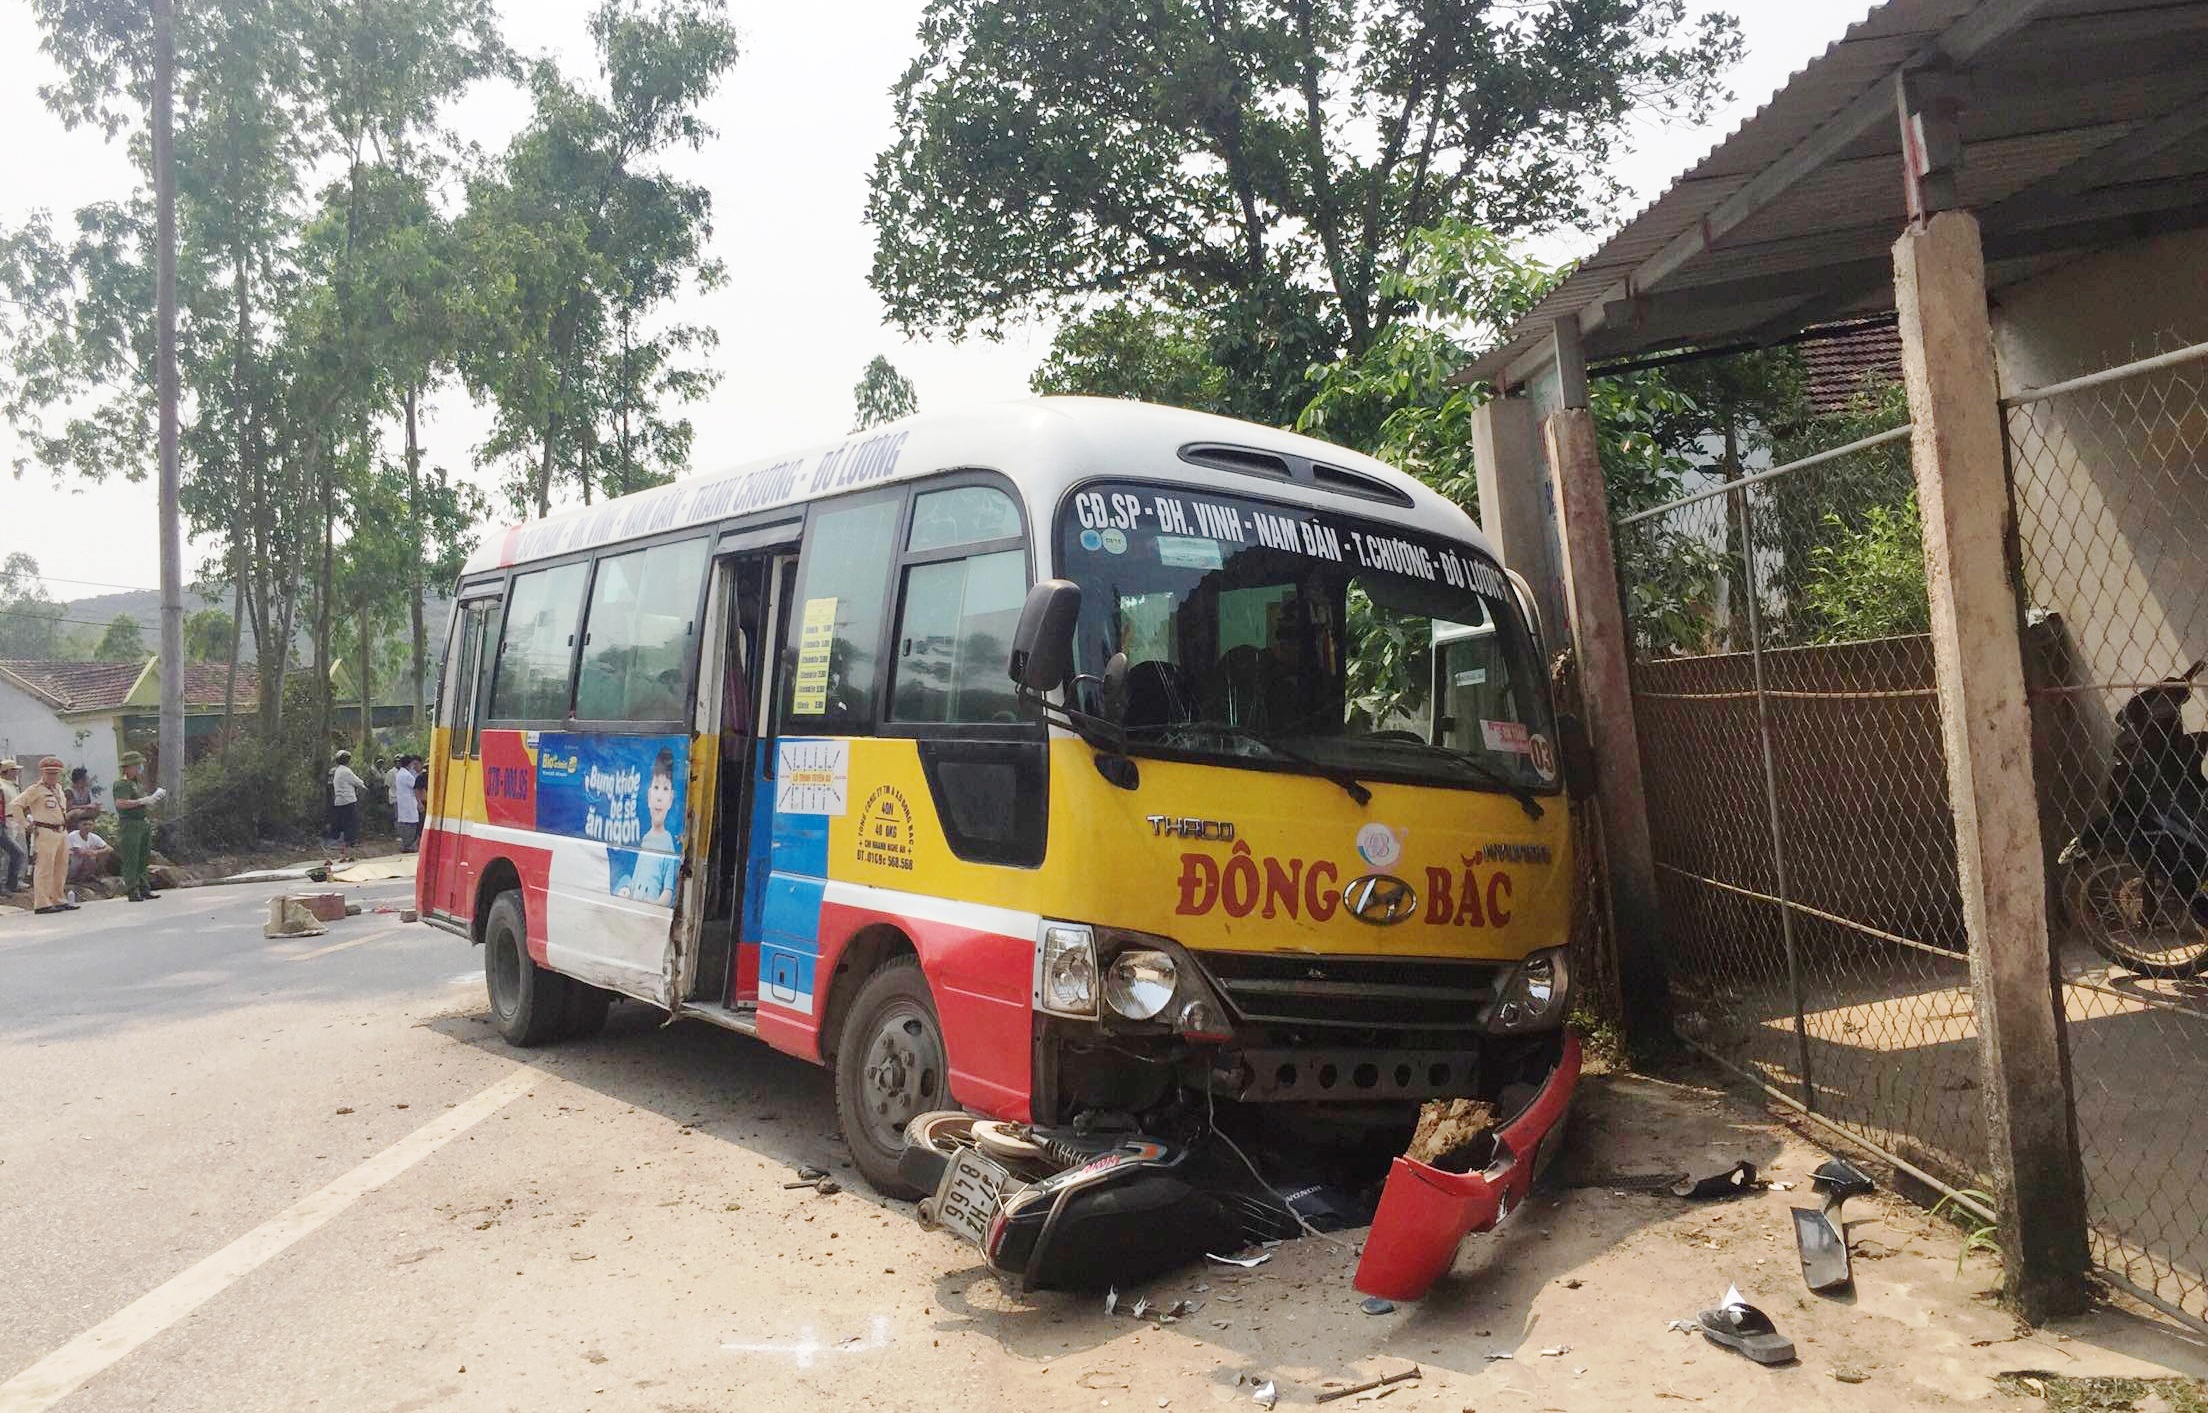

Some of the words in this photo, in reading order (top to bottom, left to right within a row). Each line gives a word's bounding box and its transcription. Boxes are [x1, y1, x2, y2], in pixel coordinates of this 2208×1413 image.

[687, 475, 741, 522] THANH
[836, 431, 910, 486] LƯƠNG
[1194, 502, 1244, 544] VINH
[1253, 511, 1302, 554] NAM
[1299, 517, 1343, 562] ĐÀN
[1438, 547, 1465, 589] ĐÔ
[585, 805, 603, 839] ăn
[604, 817, 641, 844] ngon
[1145, 814, 1236, 842] THACO
[1175, 839, 1341, 923] ĐÔNG
[1423, 850, 1513, 928] BẮC
